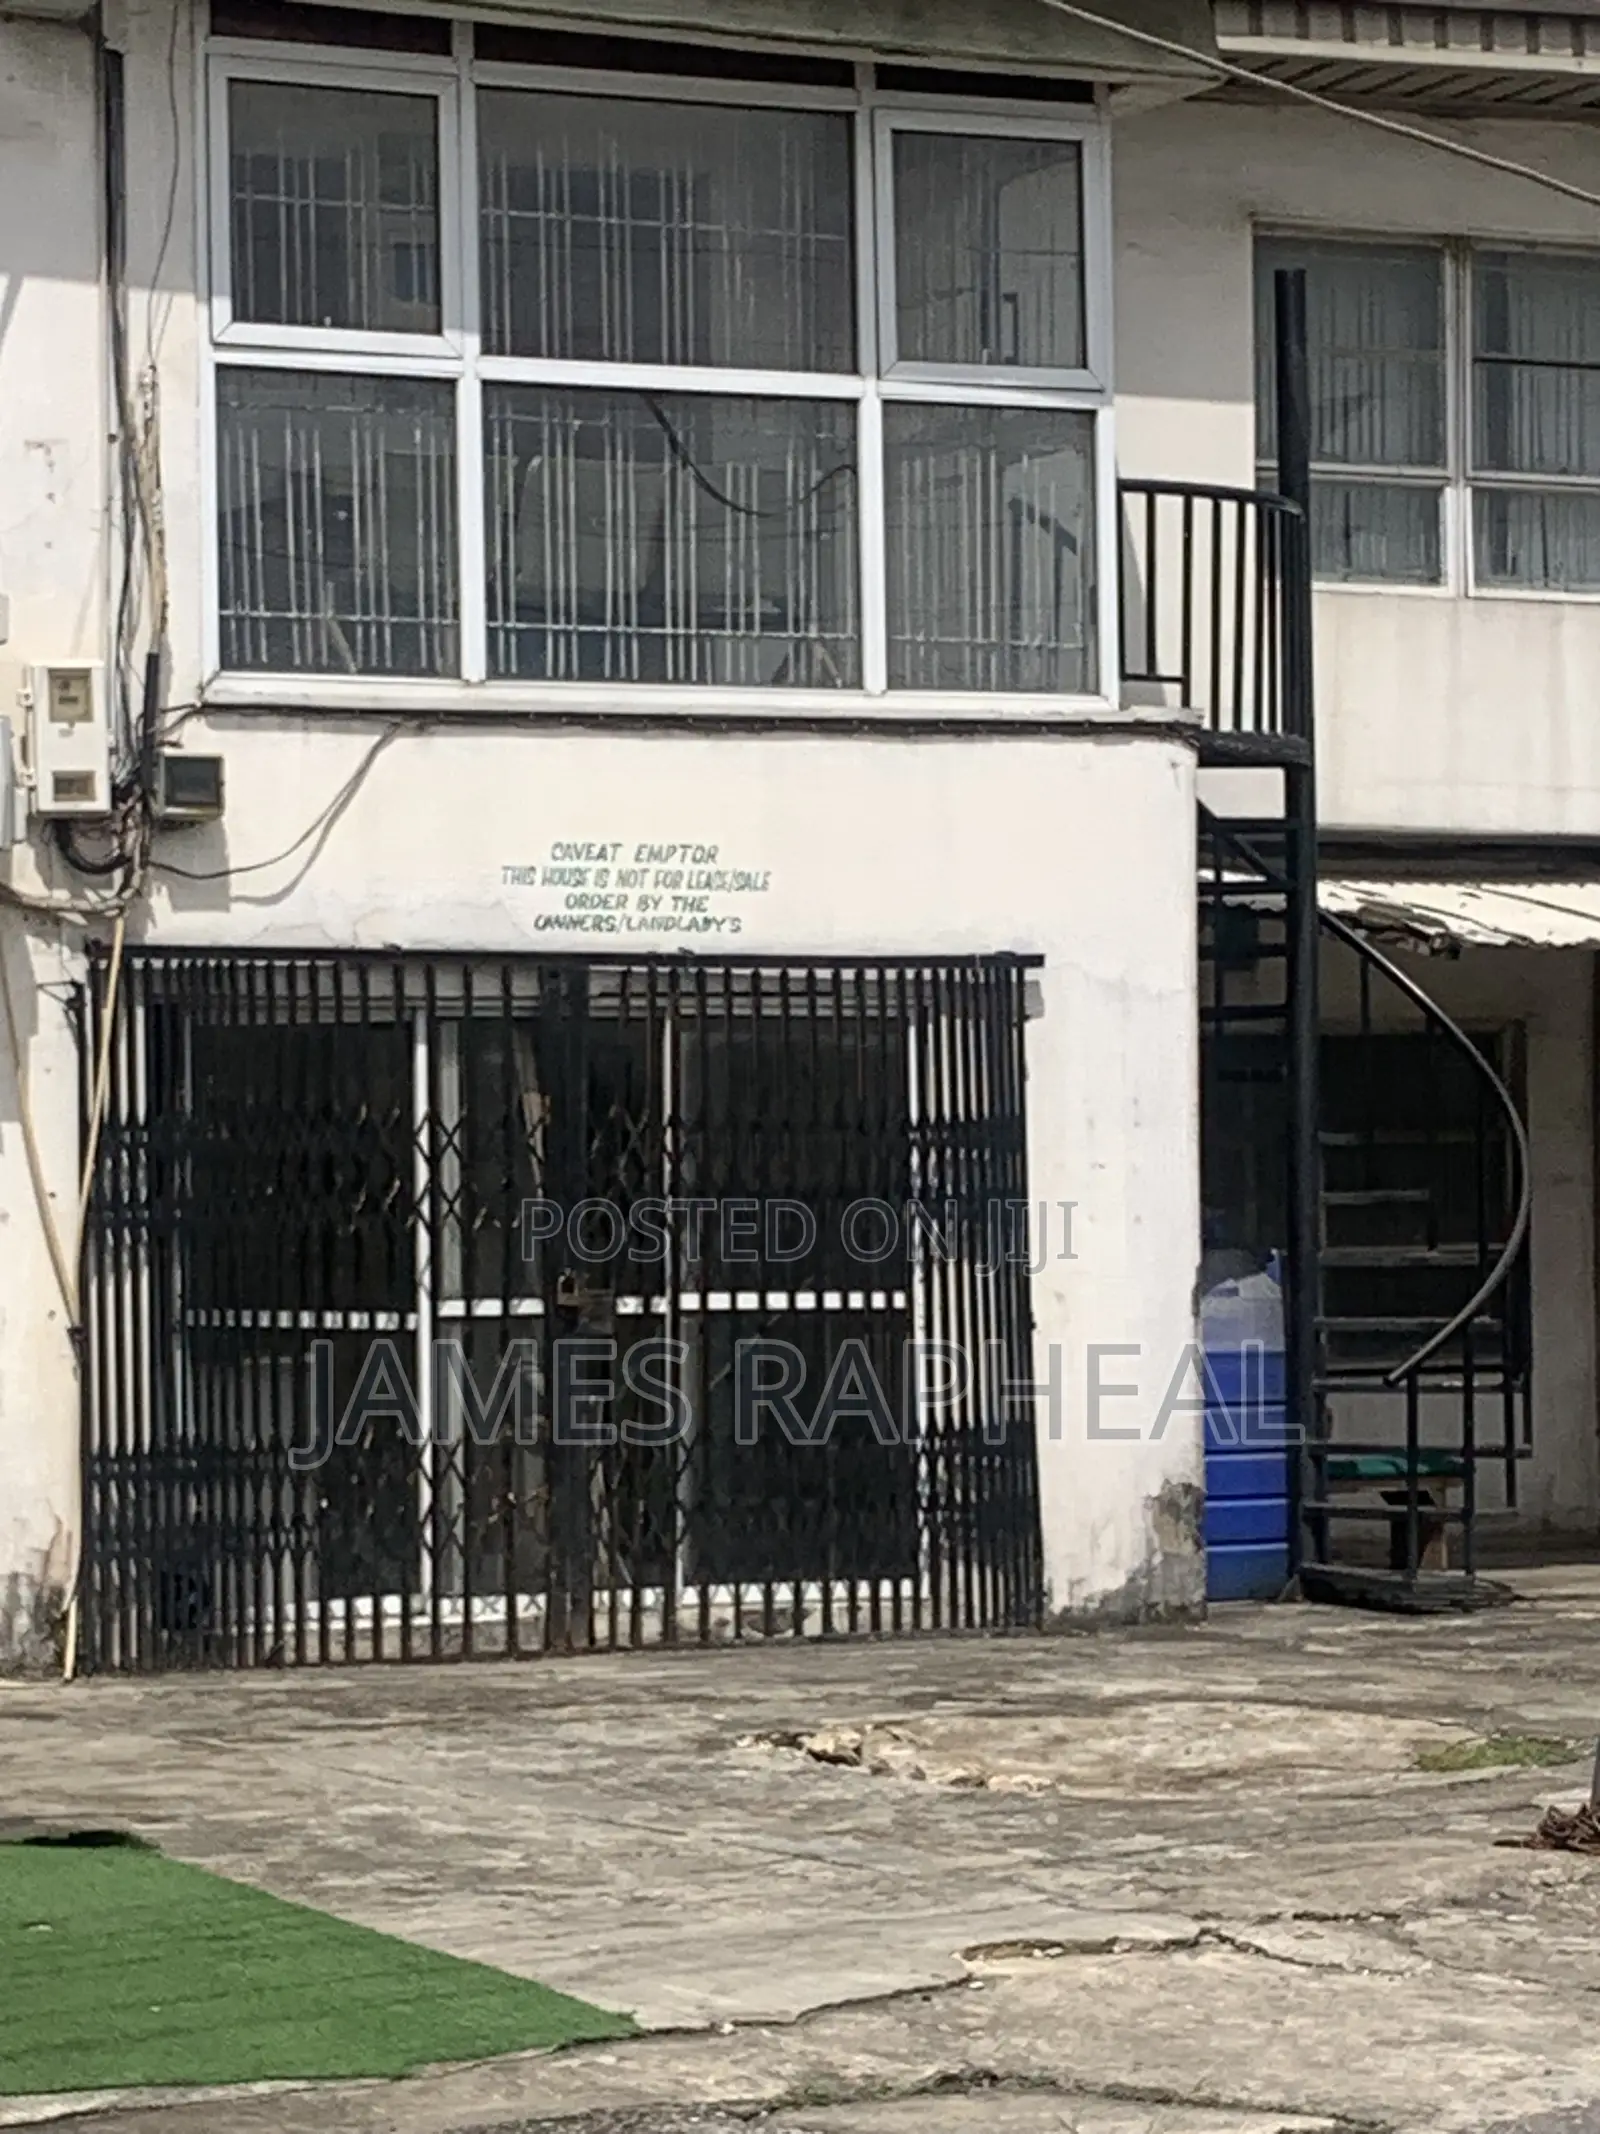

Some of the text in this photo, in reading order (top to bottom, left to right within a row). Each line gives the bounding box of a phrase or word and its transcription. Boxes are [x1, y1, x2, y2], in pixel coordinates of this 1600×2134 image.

[551, 841, 720, 864] CAVEAT EMPTOR
[501, 865, 537, 886] THIS
[541, 866, 593, 887] HOUSE
[594, 867, 612, 889] IS
[615, 867, 651, 890] NOT
[653, 869, 684, 890] FOR
[564, 892, 710, 913] ORDER BY THE
